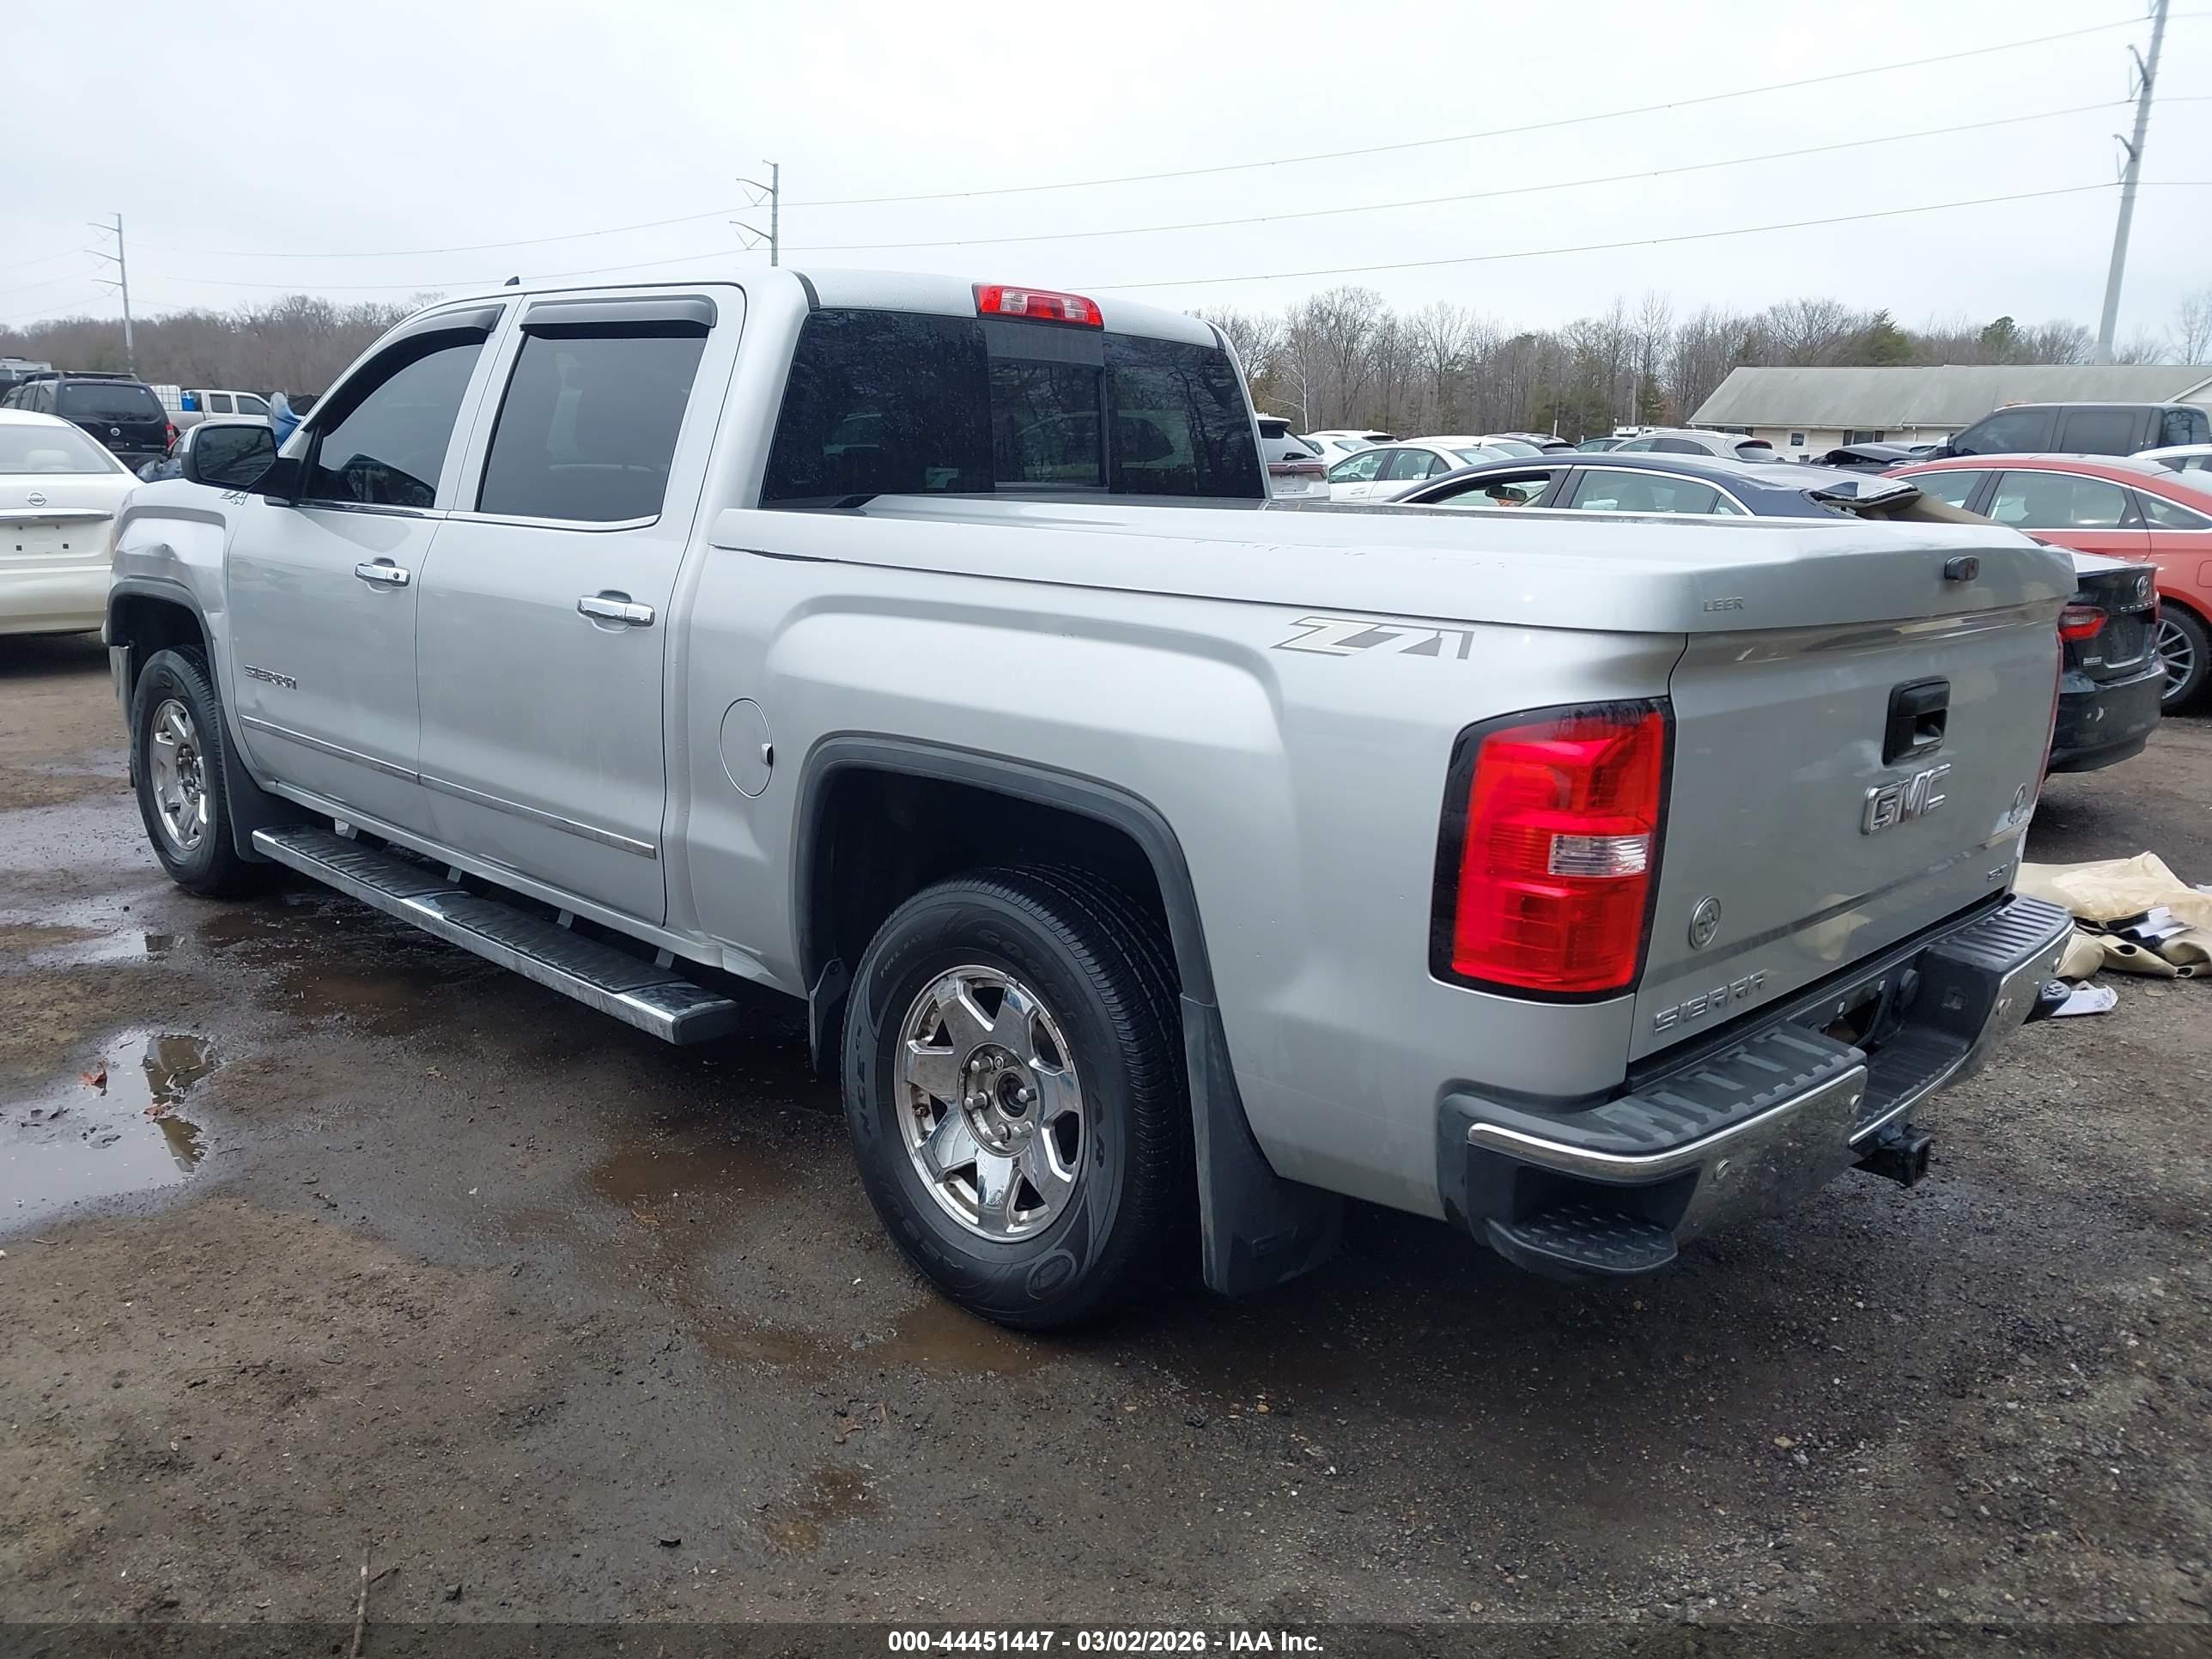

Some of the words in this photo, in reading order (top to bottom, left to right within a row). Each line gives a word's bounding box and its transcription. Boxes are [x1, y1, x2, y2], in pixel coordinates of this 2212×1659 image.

[1703, 597, 1744, 611] LEER
[244, 665, 297, 690] SIERRA
[1862, 763, 1951, 835] GMC
[1654, 968, 1769, 1036] SIERRA
